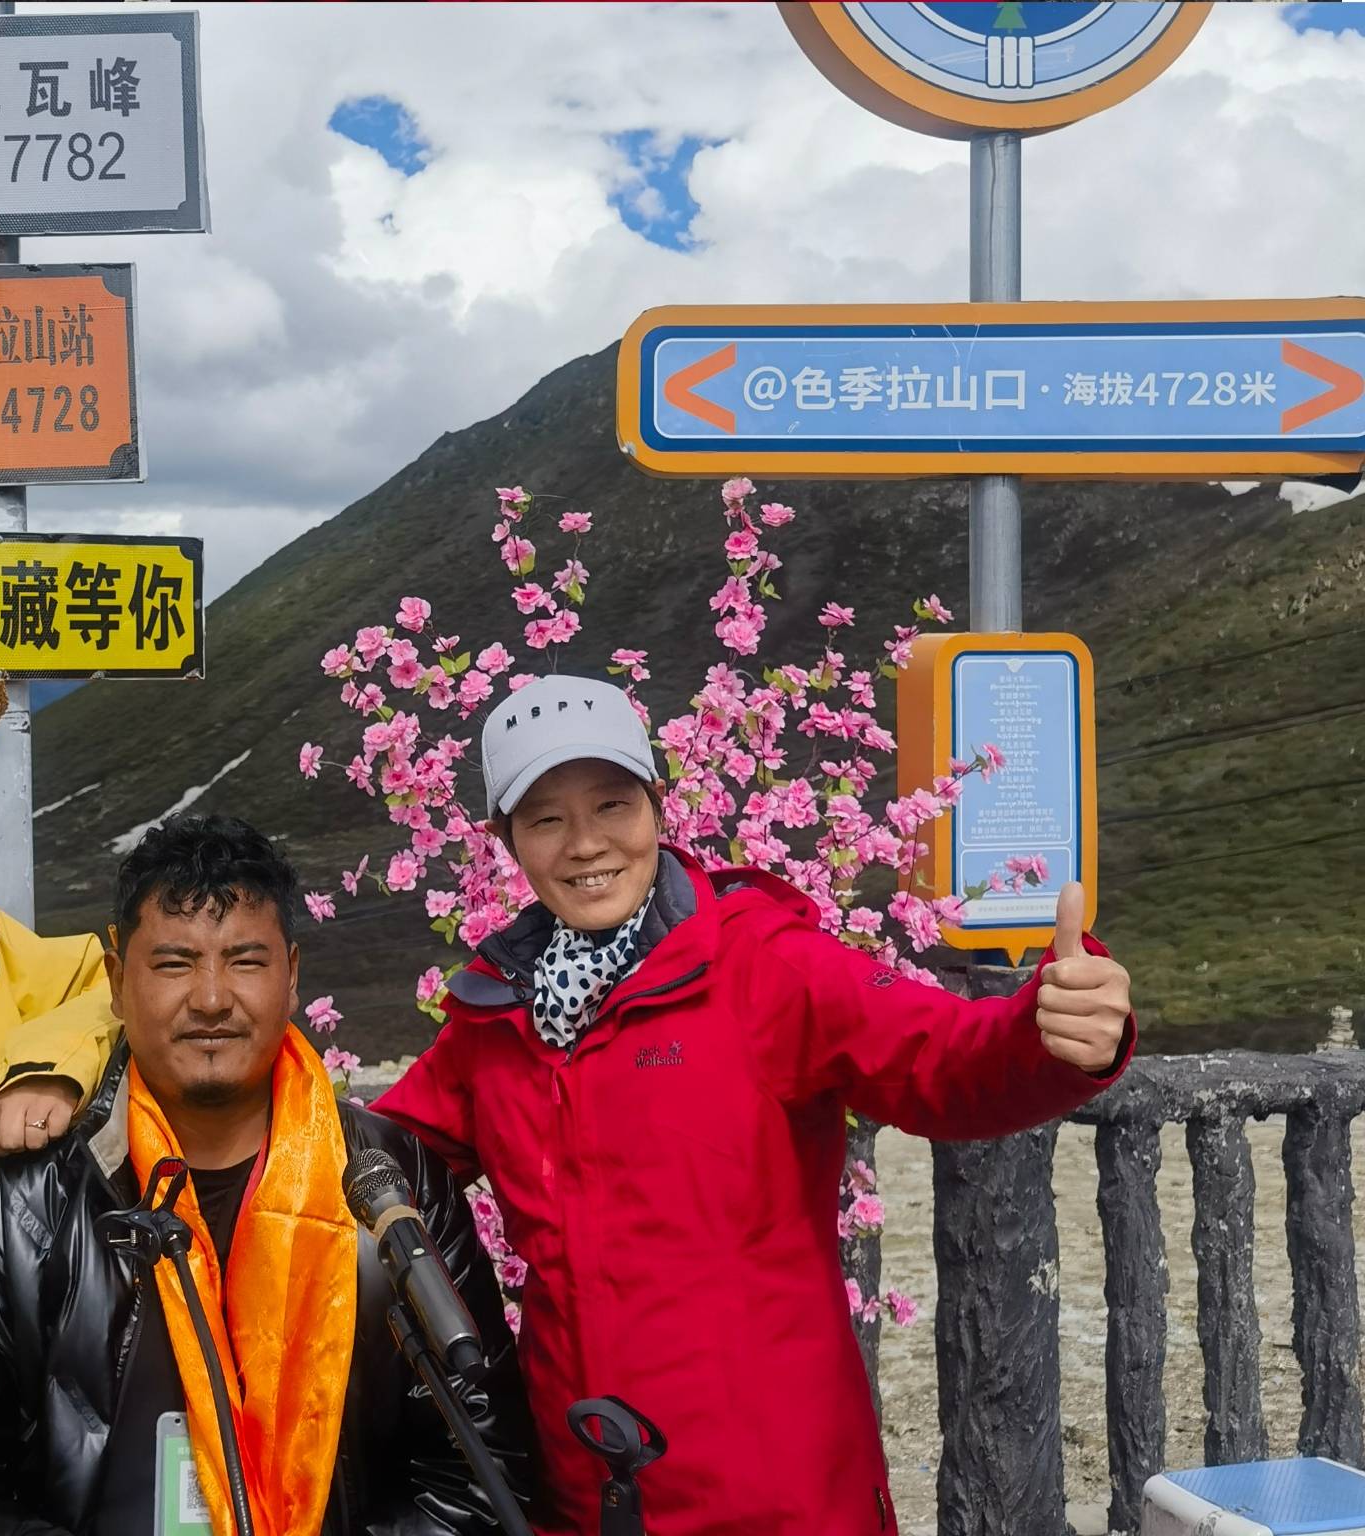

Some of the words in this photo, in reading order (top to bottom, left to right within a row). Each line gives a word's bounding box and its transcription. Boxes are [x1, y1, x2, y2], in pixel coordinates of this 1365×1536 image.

[3, 131, 127, 183] 7782
[1, 384, 101, 434] 4728
[506, 698, 595, 731] MSPY
